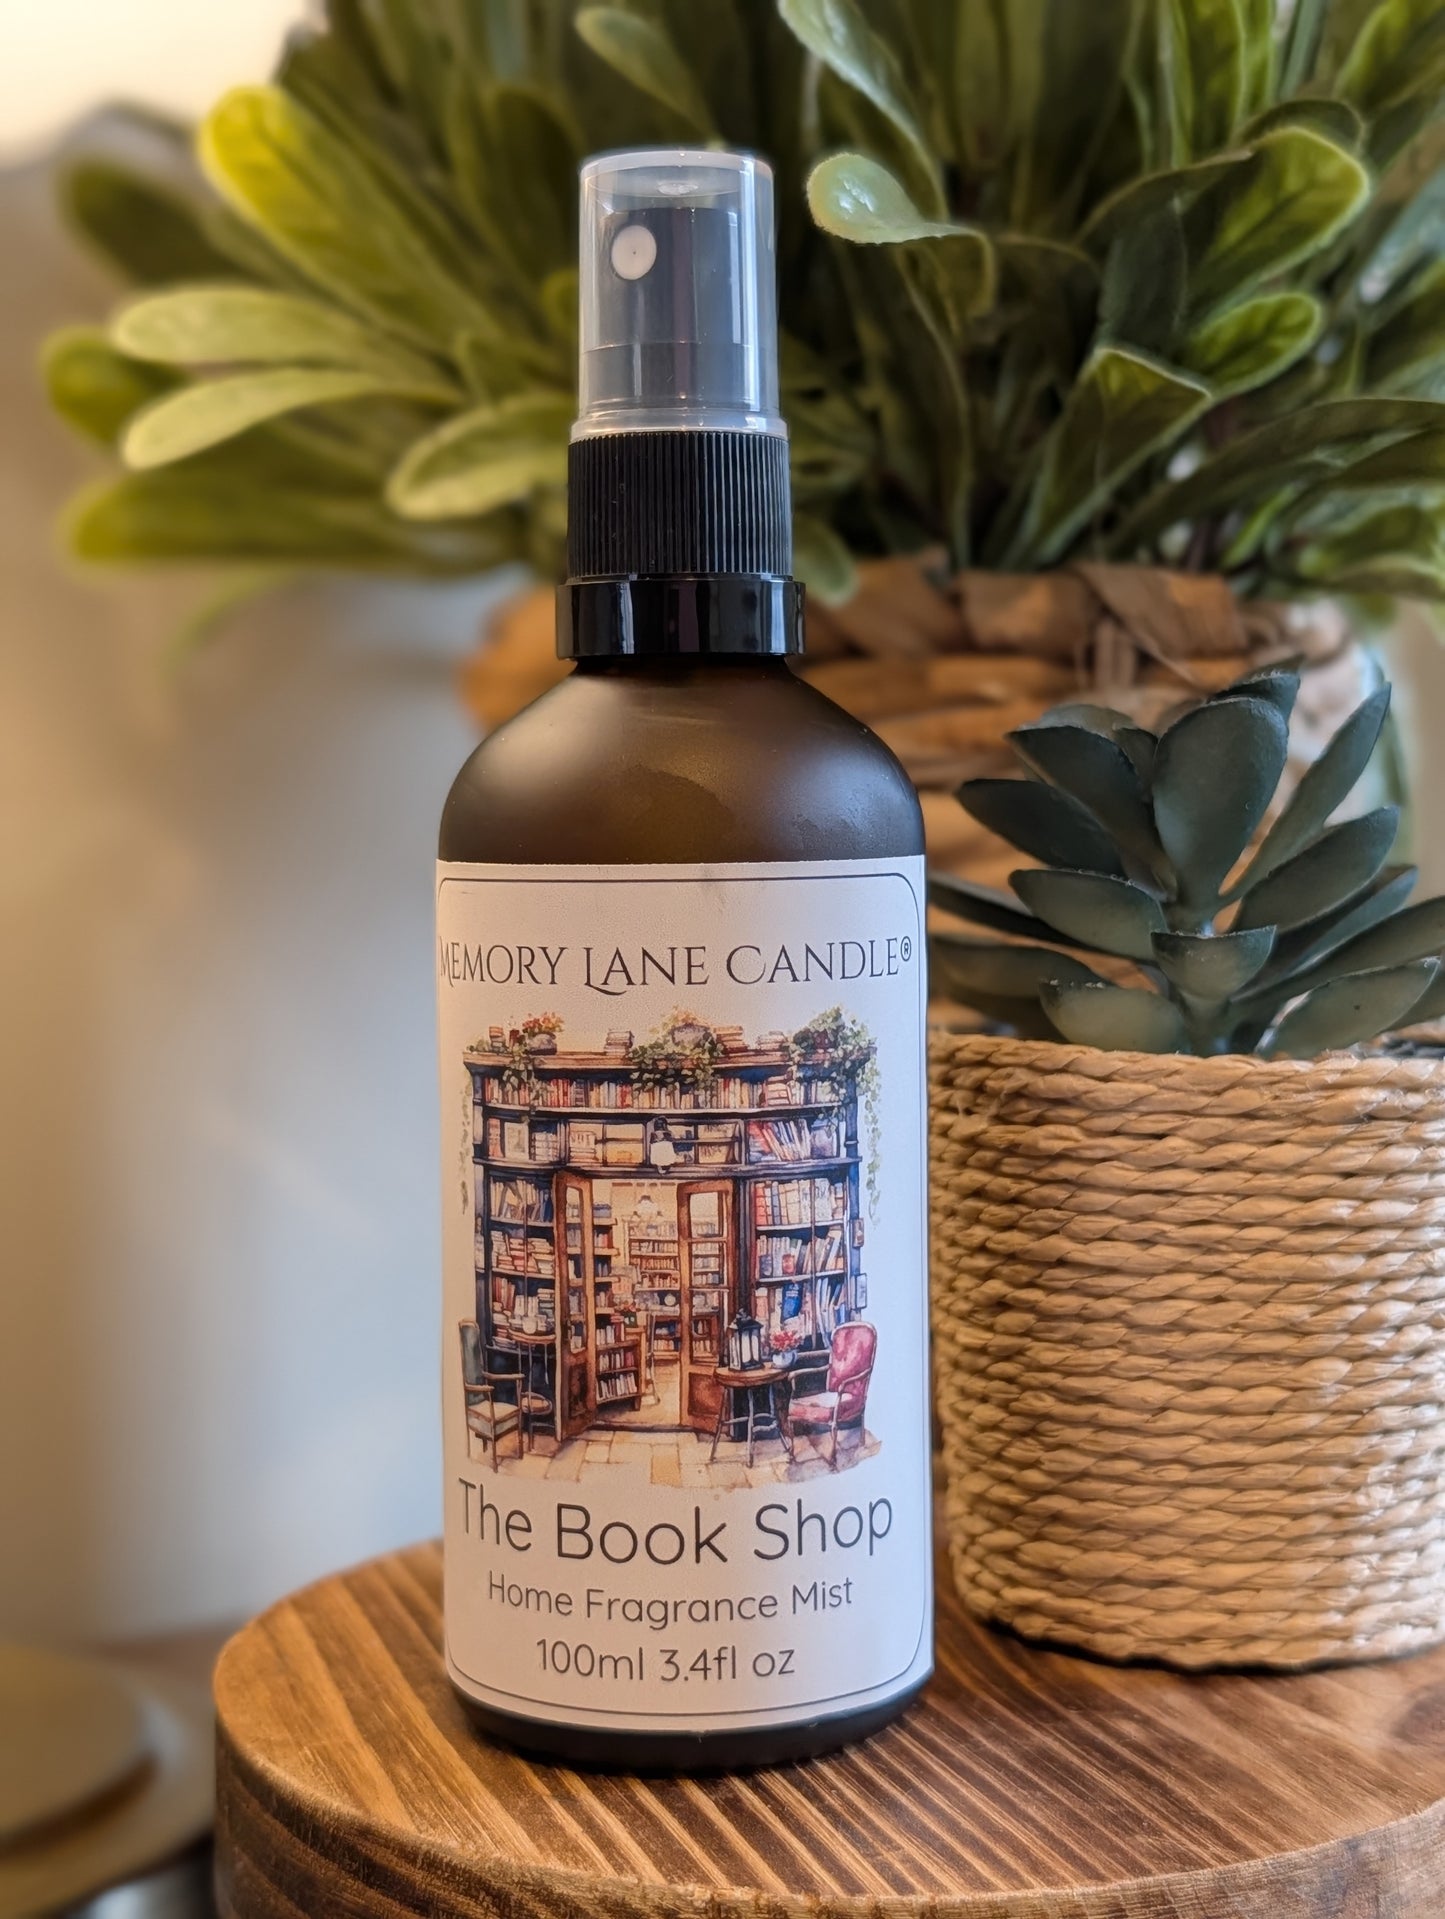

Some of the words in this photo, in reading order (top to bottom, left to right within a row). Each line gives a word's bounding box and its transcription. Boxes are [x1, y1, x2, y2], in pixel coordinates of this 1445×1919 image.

[438, 935, 567, 988] MEMORY
[583, 944, 710, 996] LANE
[458, 1477, 532, 1551] The
[556, 1502, 728, 1565] Book
[753, 1497, 893, 1561] Shop
[488, 1570, 573, 1617] Home
[585, 1588, 778, 1631] Fragrance
[792, 1576, 853, 1615] Mist
[536, 1638, 644, 1681] 100ml
[658, 1645, 737, 1682] 3.4fl
[751, 1648, 796, 1678] oz
